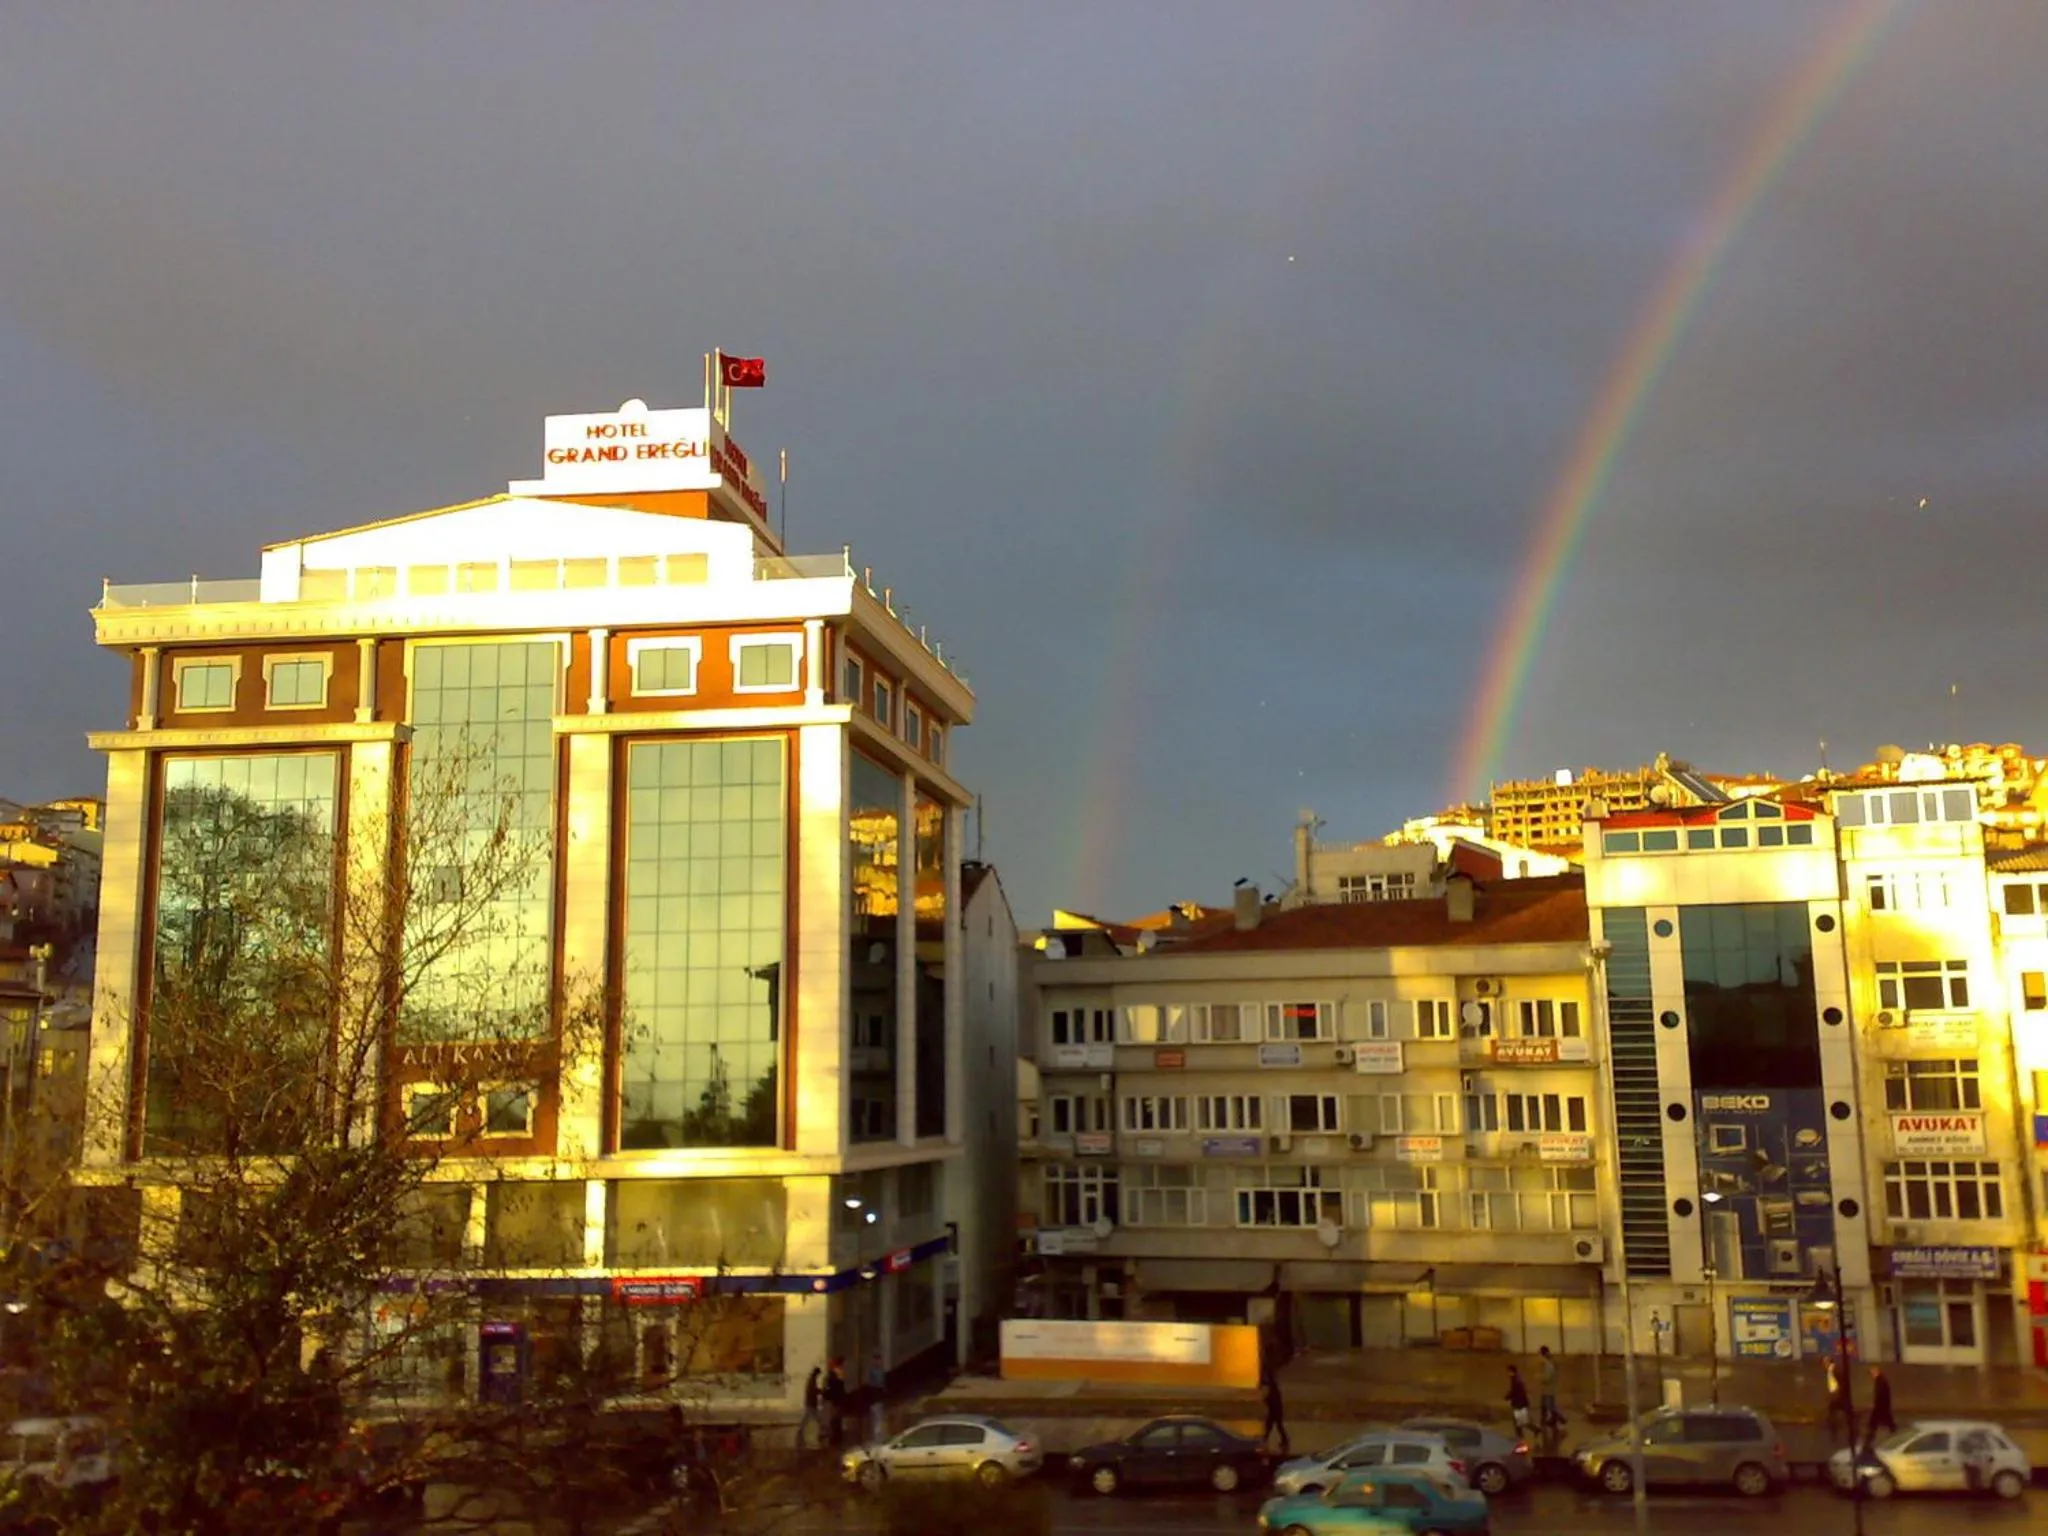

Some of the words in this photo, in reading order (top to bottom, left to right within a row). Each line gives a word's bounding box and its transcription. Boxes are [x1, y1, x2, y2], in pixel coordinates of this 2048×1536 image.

[586, 423, 648, 440] HOTEL
[548, 446, 628, 464] GRAND
[1497, 1046, 1553, 1057] AVUKAT
[1702, 1095, 1770, 1109] BEKO
[1898, 1117, 1978, 1132] AVUKAT
